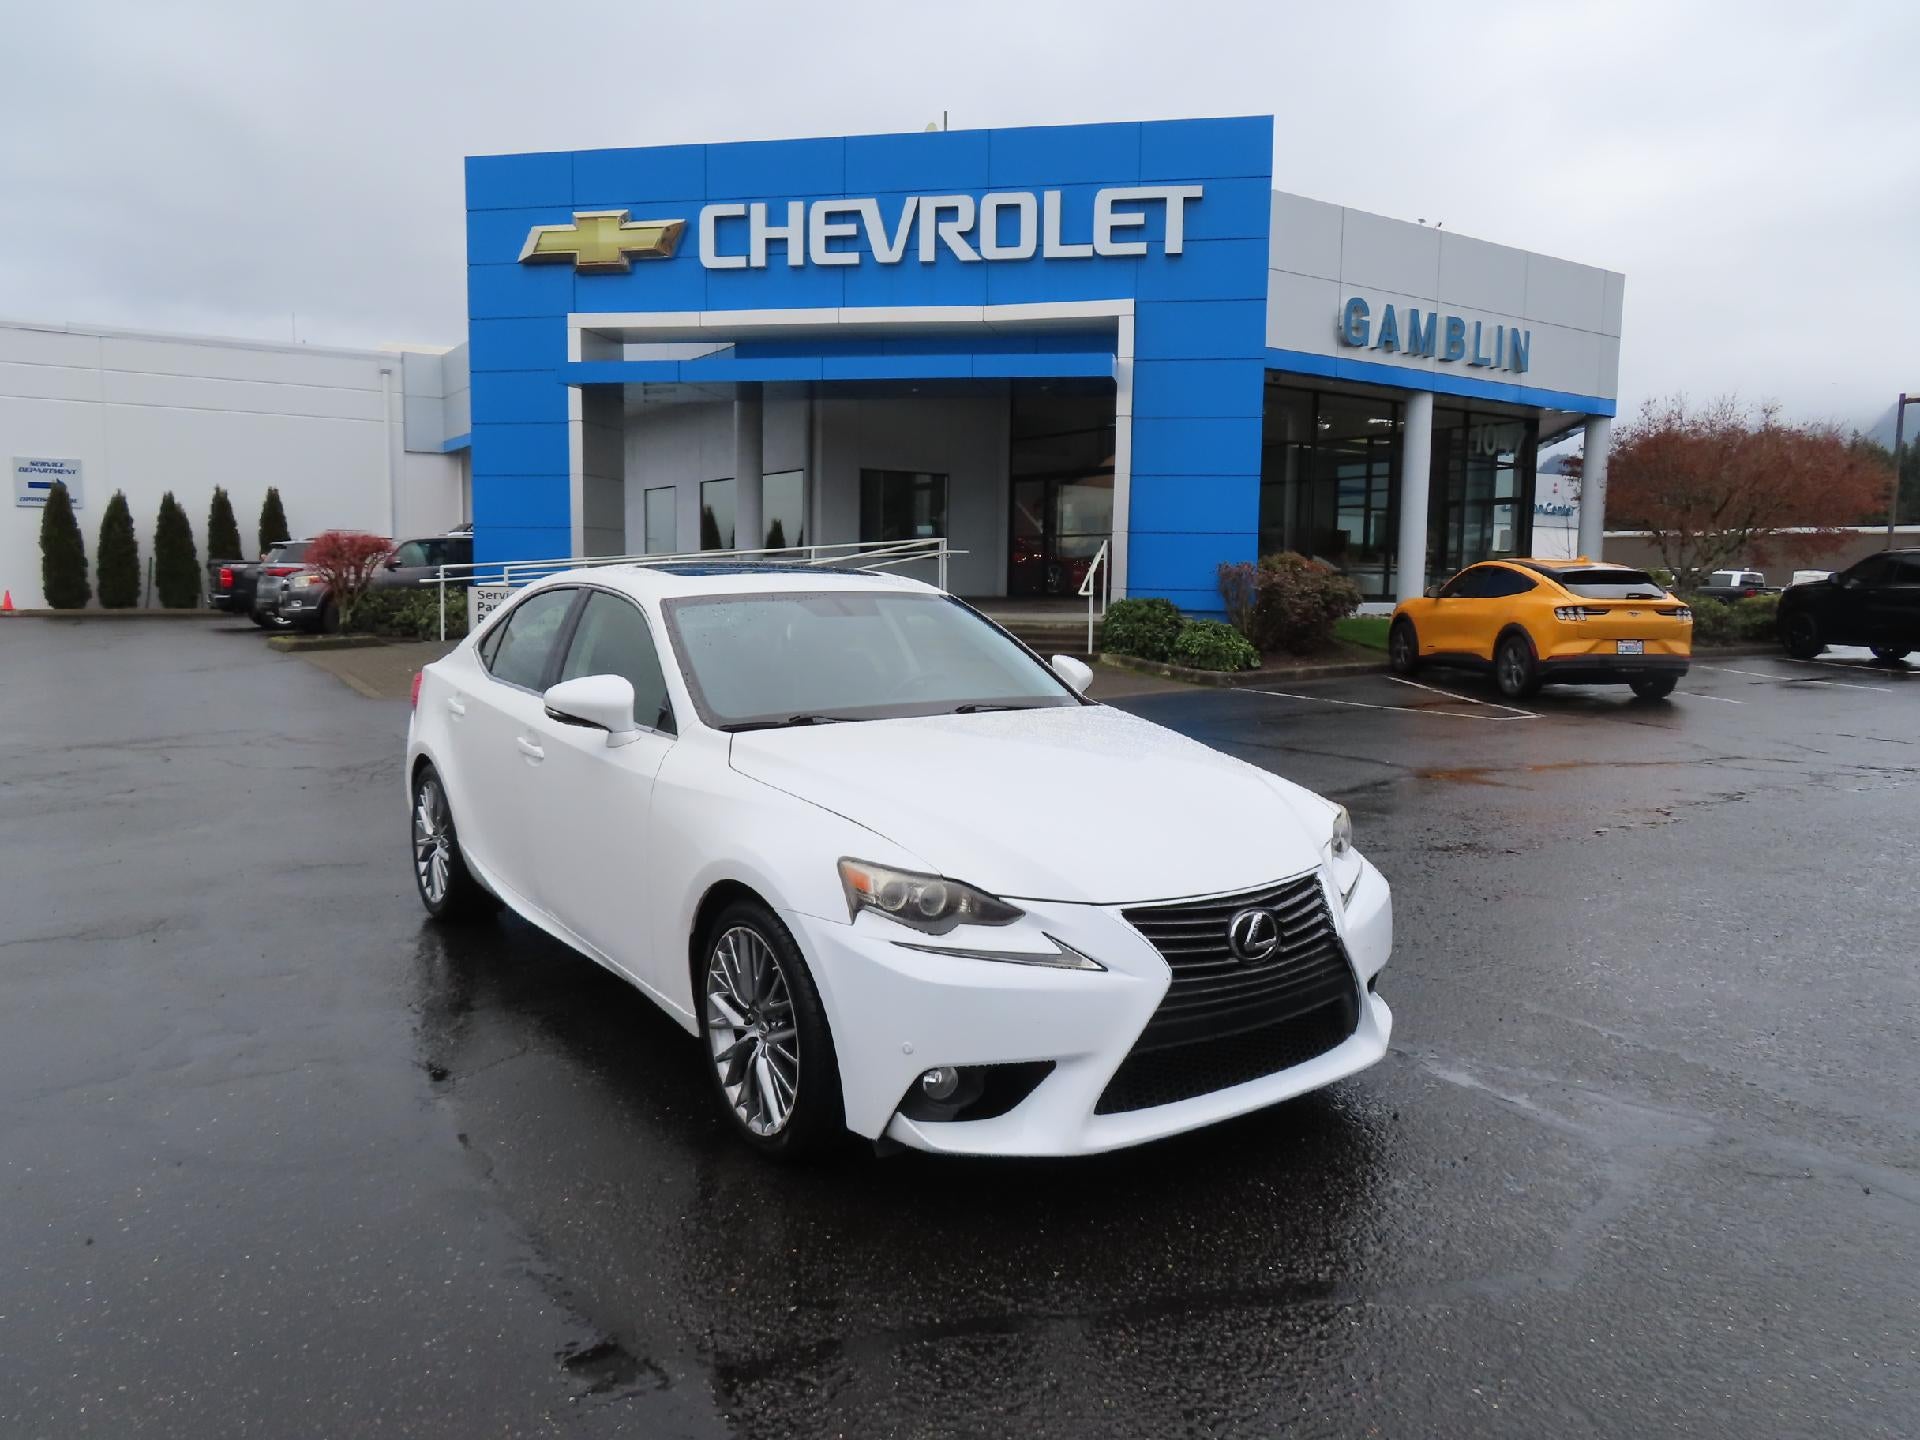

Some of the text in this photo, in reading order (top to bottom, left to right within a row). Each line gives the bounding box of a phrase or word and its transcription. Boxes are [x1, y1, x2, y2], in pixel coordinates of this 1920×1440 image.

[699, 185, 1203, 269] CHEVROLET
[1343, 296, 1530, 374] GAMBLIN
[1475, 424, 1527, 458] 107
[18, 466, 78, 475] DEPARTMENT
[29, 460, 65, 468] SERVICE
[477, 590, 514, 600] Servi
